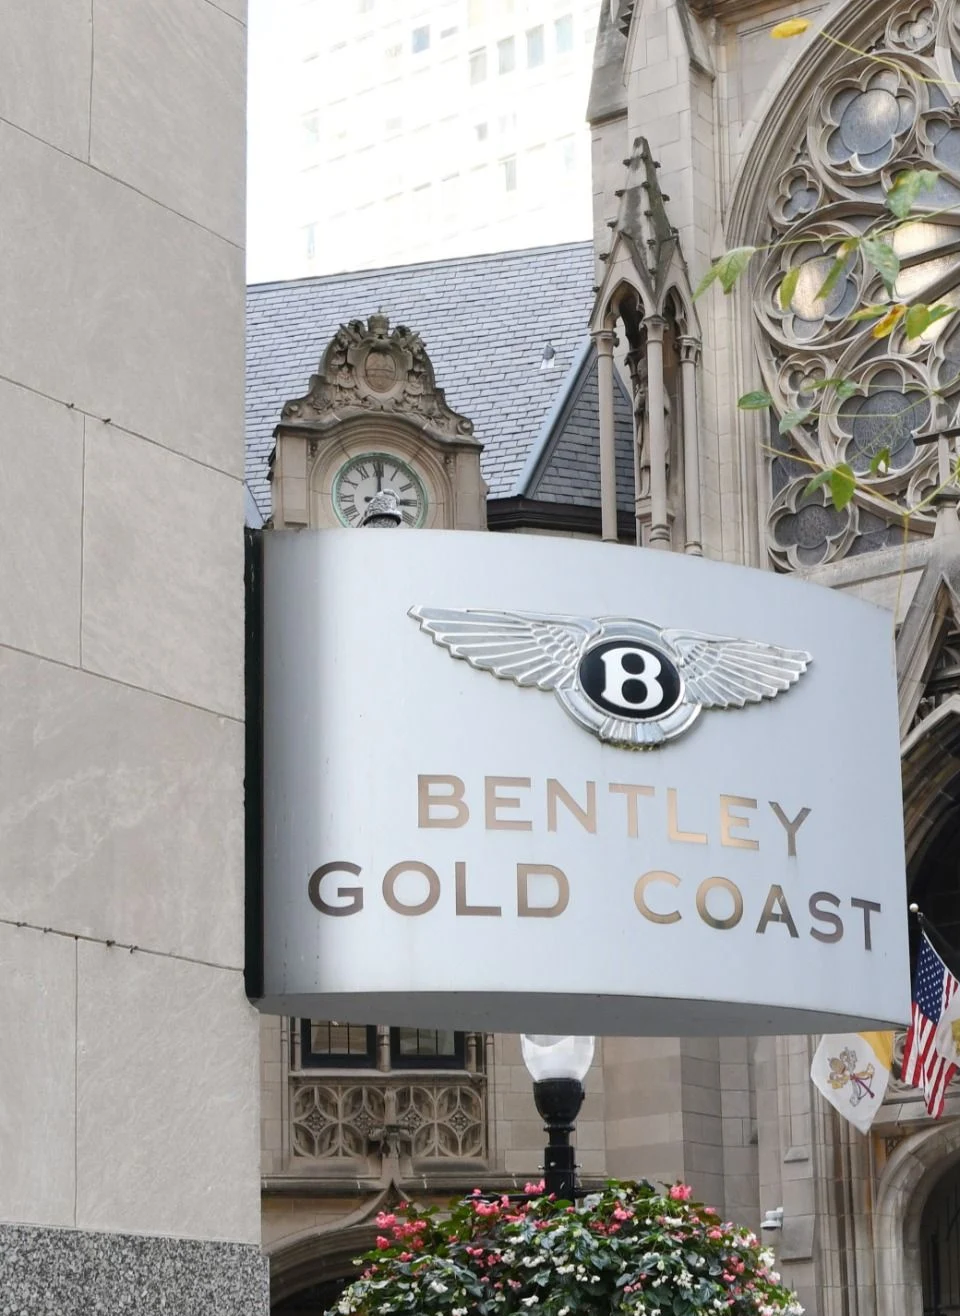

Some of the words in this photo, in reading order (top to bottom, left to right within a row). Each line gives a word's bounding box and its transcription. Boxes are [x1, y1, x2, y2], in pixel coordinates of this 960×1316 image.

[600, 647, 664, 710] B
[417, 774, 812, 857] BENTLEY
[308, 861, 570, 918] GOLD
[633, 870, 881, 951] COAST
